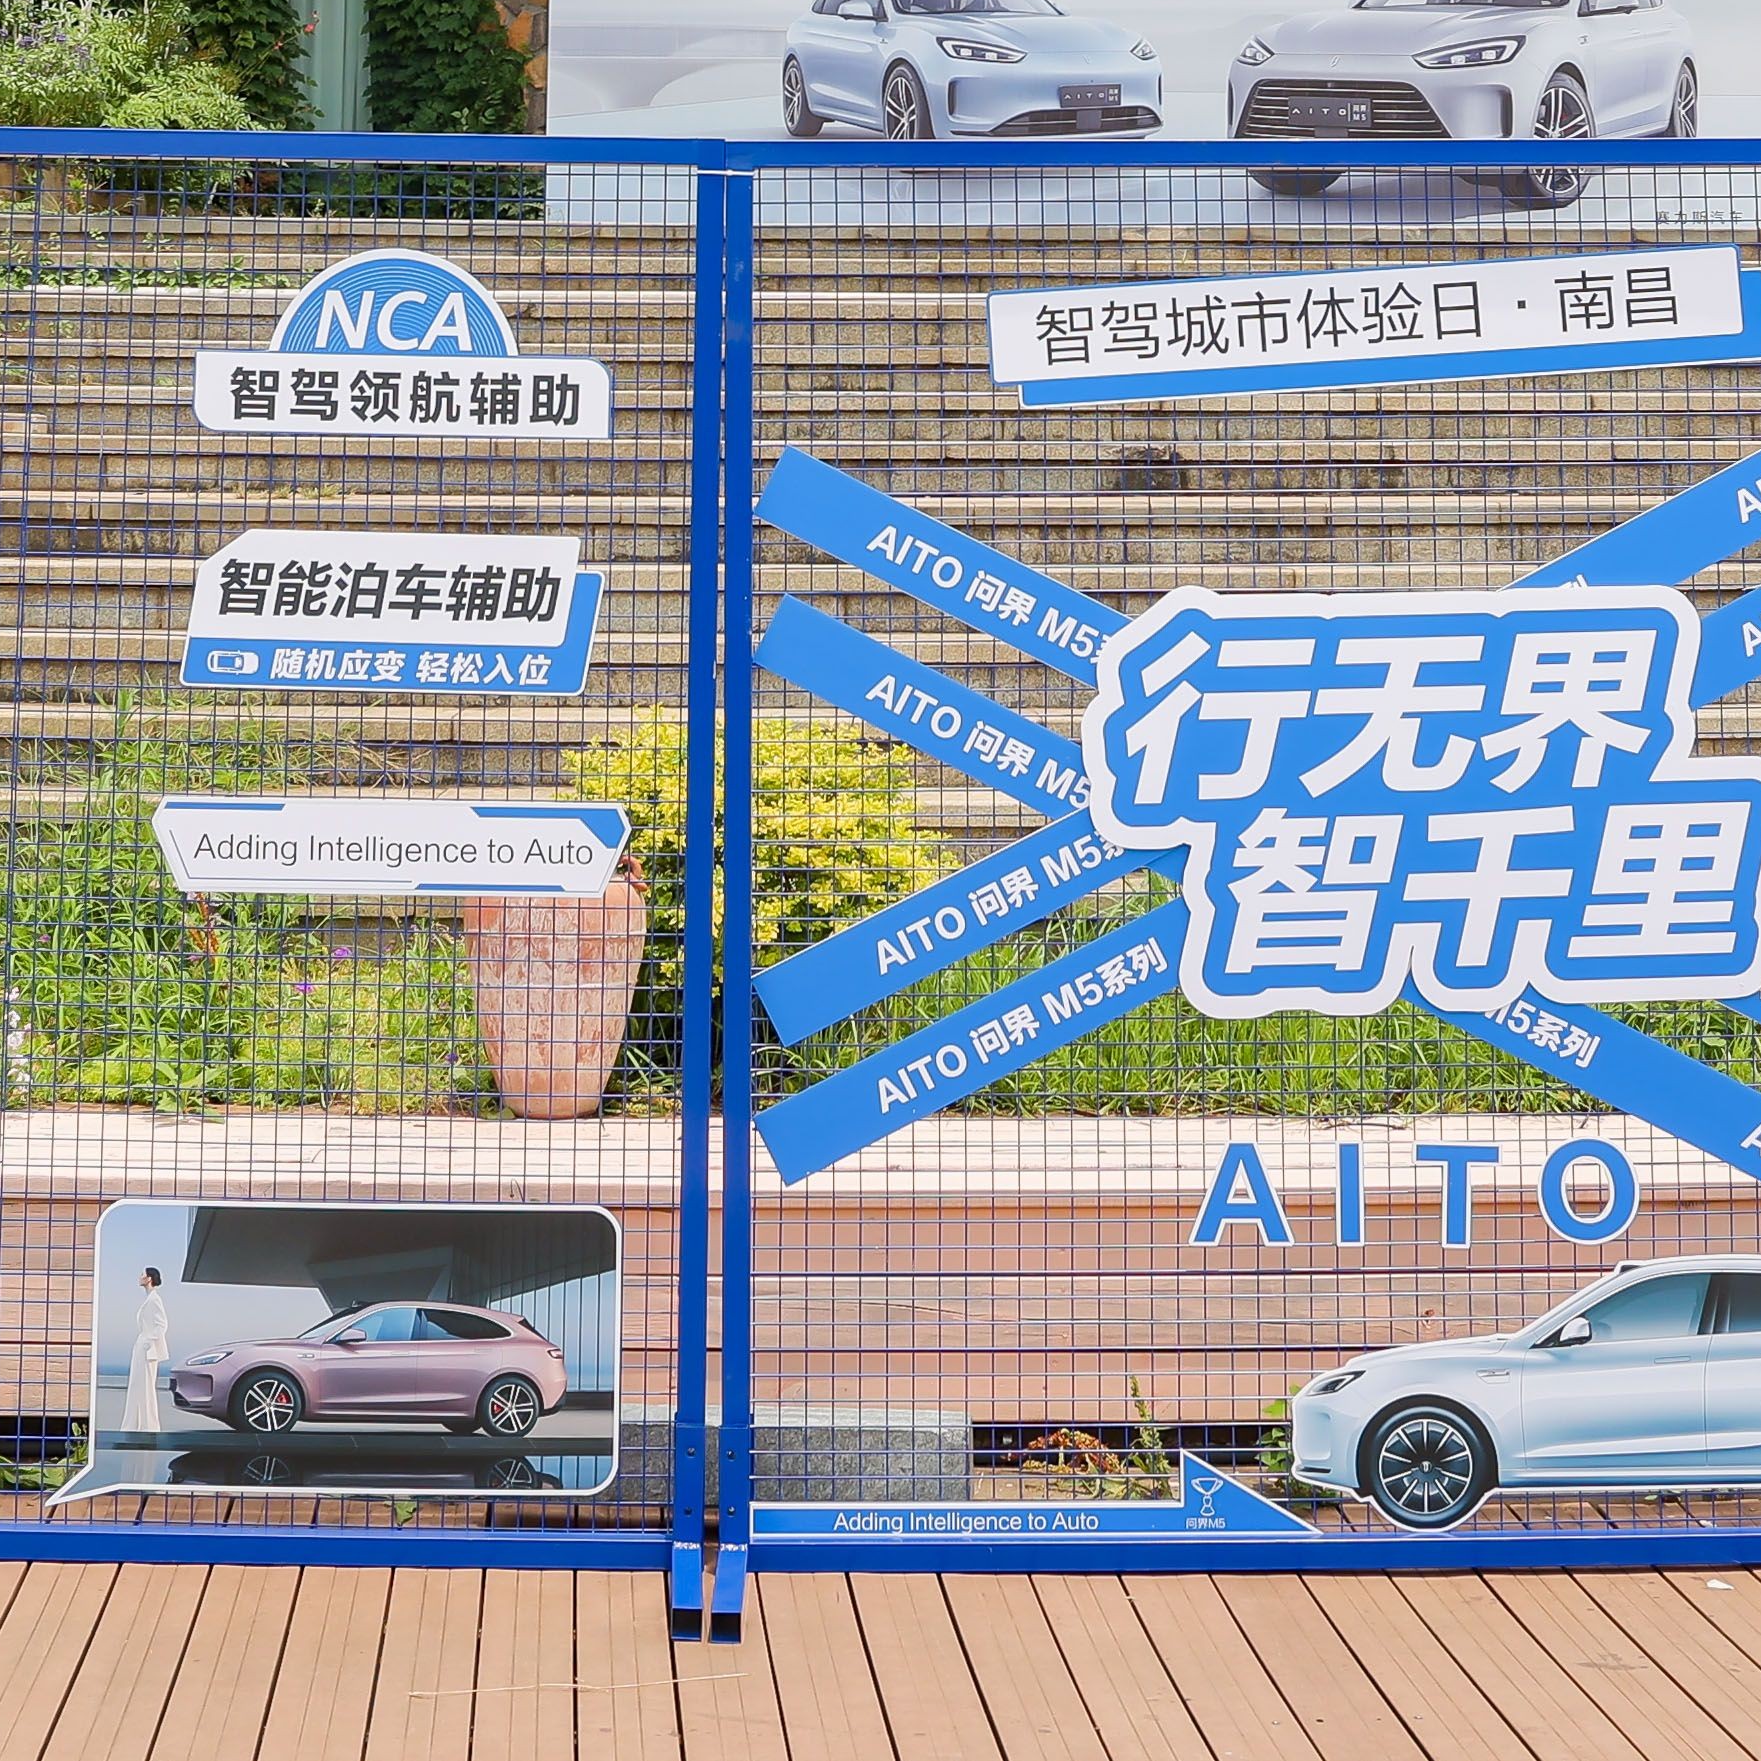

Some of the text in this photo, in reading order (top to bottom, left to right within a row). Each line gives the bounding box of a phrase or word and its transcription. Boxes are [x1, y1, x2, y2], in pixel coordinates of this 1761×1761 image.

[1292, 107, 1347, 116] AITO
[313, 289, 473, 352] NCA
[229, 366, 581, 427] 智驾领航辅助
[218, 558, 562, 623] 智能泊车辅助
[866, 524, 965, 591] AITO
[964, 570, 1037, 627] 问界
[269, 647, 552, 687] 随机应变 轻松入位
[865, 674, 962, 739] AITO
[962, 720, 1036, 778] 问界
[1125, 625, 1660, 802] 行无界
[193, 832, 594, 868] Adding Intelligence to Auto
[1226, 800, 1753, 975] 智千里
[875, 905, 966, 976] AITO
[966, 867, 1040, 926] 问界
[875, 936, 1169, 1115] AITO 问界 M5系列
[1188, 1138, 1640, 1248] AITO
[834, 1512, 1099, 1534] Adding Intelligence to Auto
[1186, 1518, 1226, 1529] 问界M5
